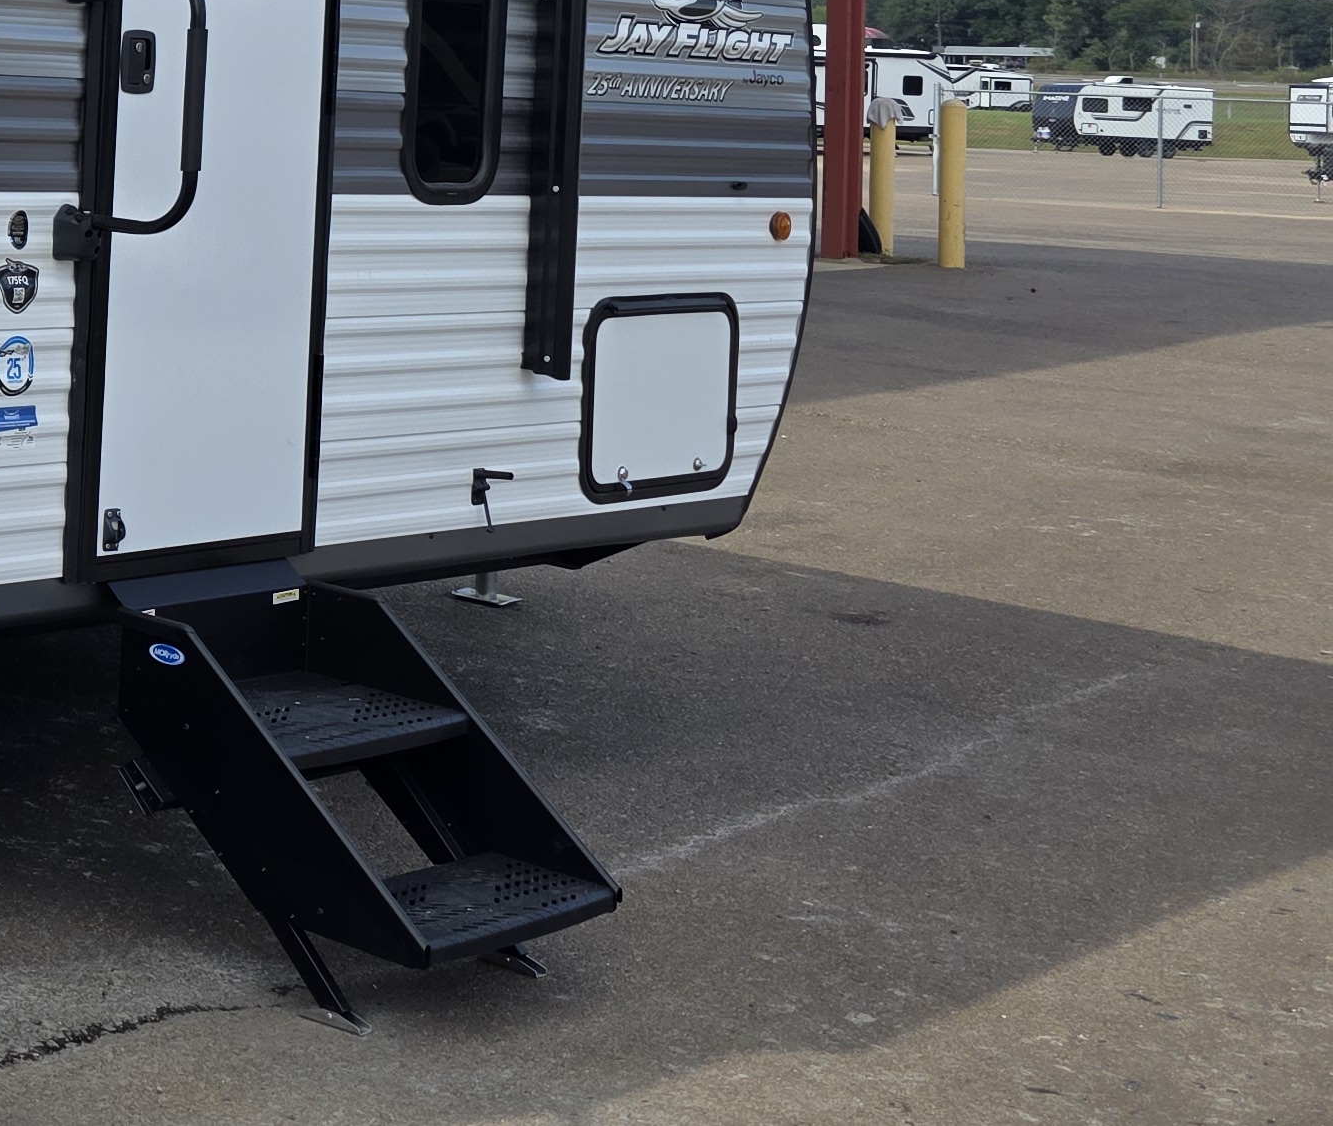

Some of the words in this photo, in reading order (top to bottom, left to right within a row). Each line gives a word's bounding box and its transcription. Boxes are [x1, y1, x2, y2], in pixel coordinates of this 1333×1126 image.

[598, 16, 673, 56] JAY
[668, 23, 794, 64] FLIGHT
[586, 72, 623, 97] 25th
[620, 75, 735, 103] ANNIVERSARY
[749, 69, 784, 88] Jayco
